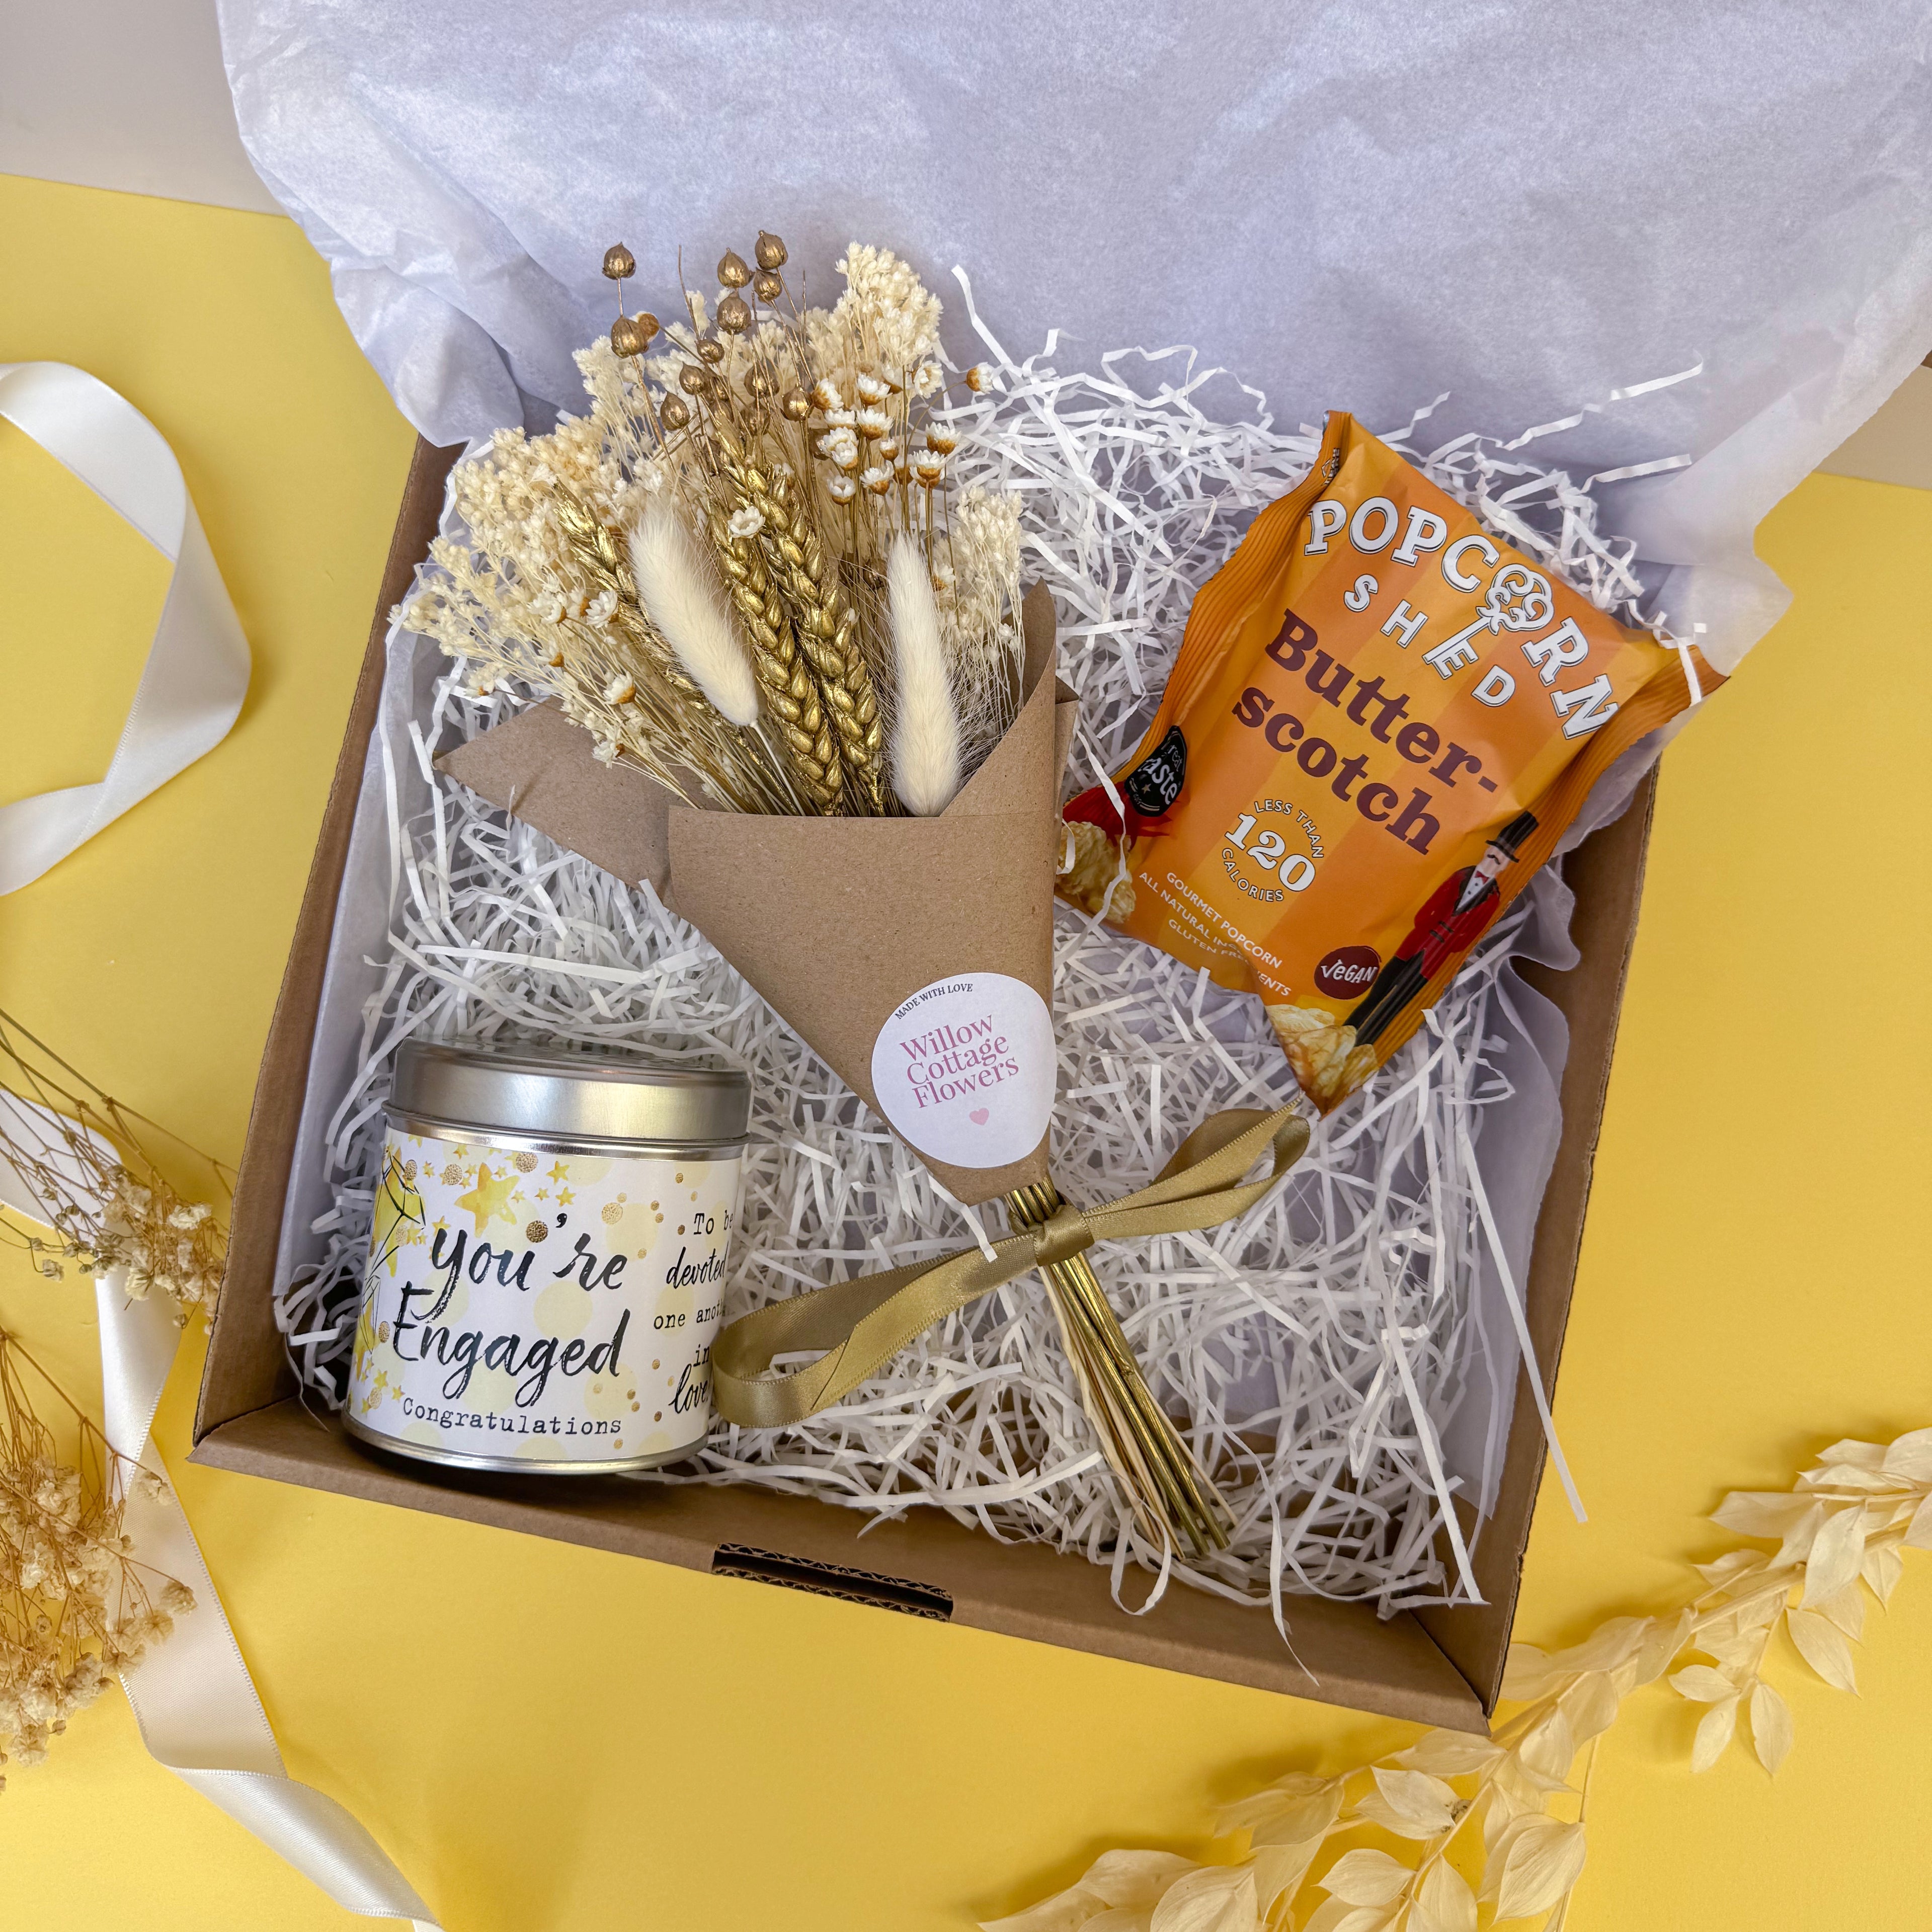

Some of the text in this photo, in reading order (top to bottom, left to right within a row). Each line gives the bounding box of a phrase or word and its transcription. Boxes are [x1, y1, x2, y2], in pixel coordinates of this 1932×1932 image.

[1265, 608, 1498, 793] Butter-
[1162, 745, 1182, 772] reat
[1232, 687, 1440, 855] scotch
[1225, 813, 1316, 892] 120
[1254, 799, 1324, 858] LESS THAN
[1222, 848, 1284, 902] CALORIES
[1139, 872, 1159, 893] ALL
[1160, 890, 1211, 939] NATURAL
[1167, 872, 1282, 969] GOURMET POPCORN
[1168, 919, 1217, 954] GLUTEN
[895, 984, 973, 1020] MADE WITH LOVE
[900, 1014, 992, 1061] Willow
[907, 1035, 1009, 1085] Cottage
[912, 1057, 1019, 1108] Flowers
[693, 1209, 734, 1235] To be
[666, 1241, 729, 1290] devoted
[392, 1280, 630, 1408] Engaged
[653, 1314, 686, 1330] one
[693, 1344, 710, 1367] in
[403, 1397, 621, 1435] Congratulations
